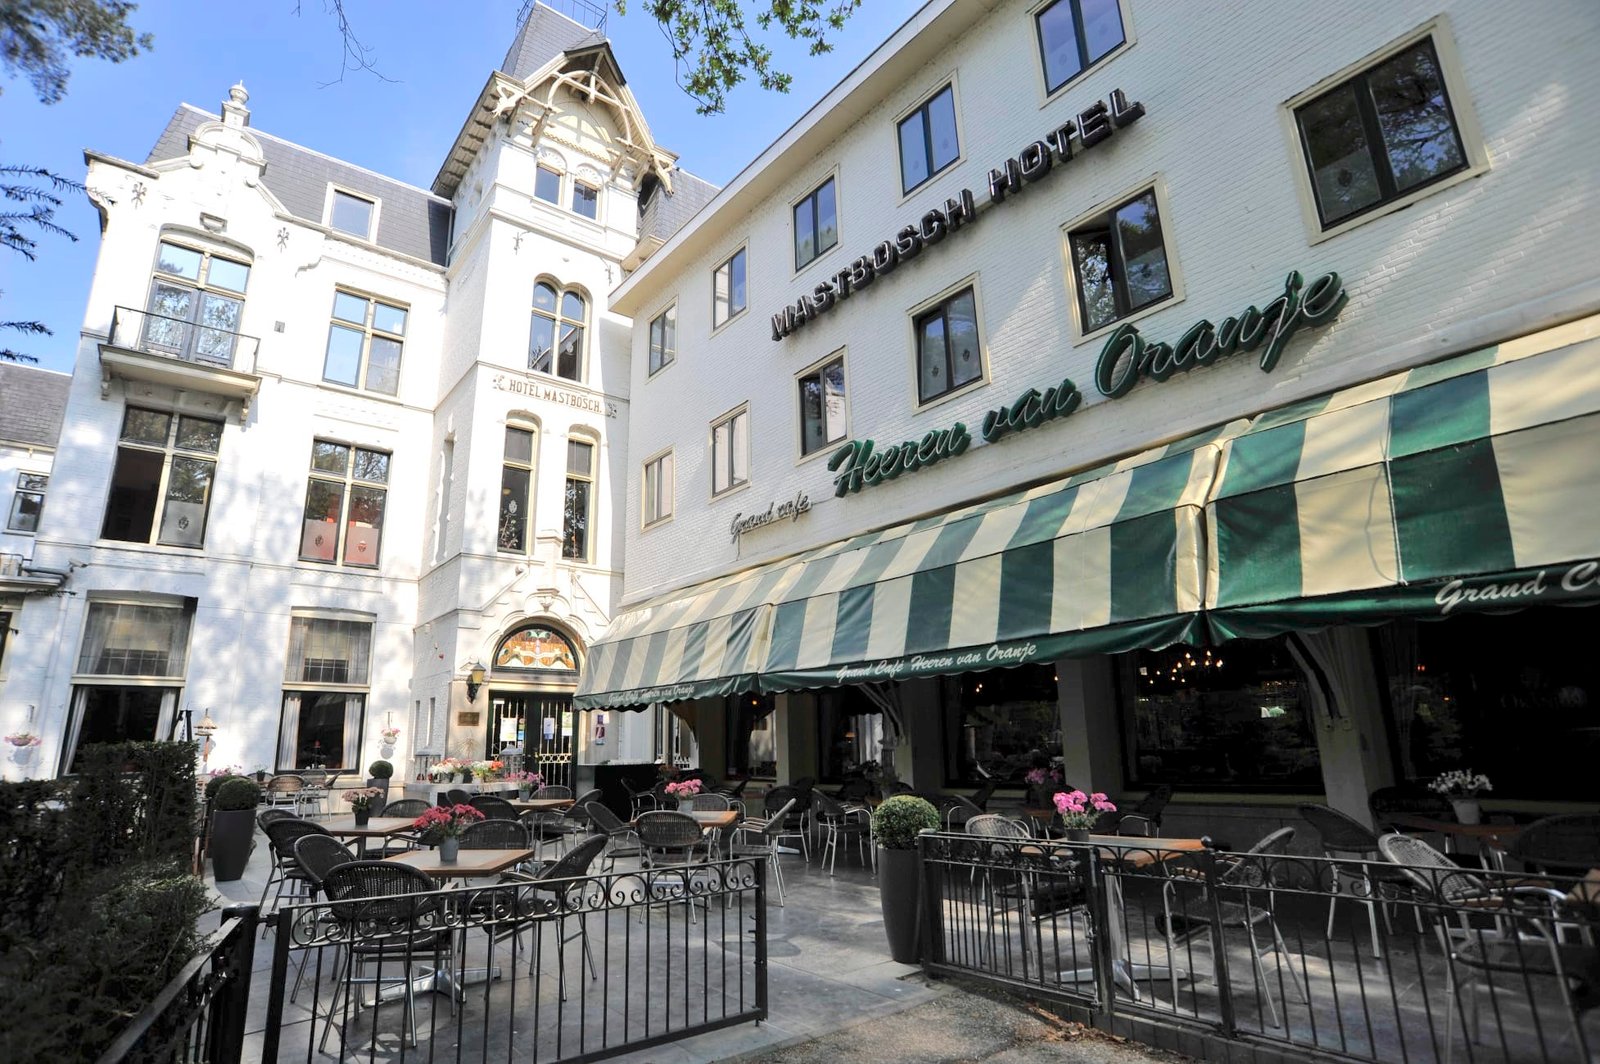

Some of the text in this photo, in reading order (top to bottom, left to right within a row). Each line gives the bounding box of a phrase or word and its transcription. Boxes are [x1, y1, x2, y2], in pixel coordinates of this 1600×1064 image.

[771, 88, 1146, 341] MASTBOSCH HOTEL
[509, 379, 540, 397] HOTEL
[828, 270, 1350, 498] Heeren van Oranje
[730, 502, 774, 544] Grand
[1435, 561, 1600, 614] Grand C
[836, 663, 873, 684] Grand
[911, 655, 954, 672] Heeren
[957, 653, 981, 665] van
[986, 642, 1037, 662] Oranje
[674, 684, 695, 699] Oranje
